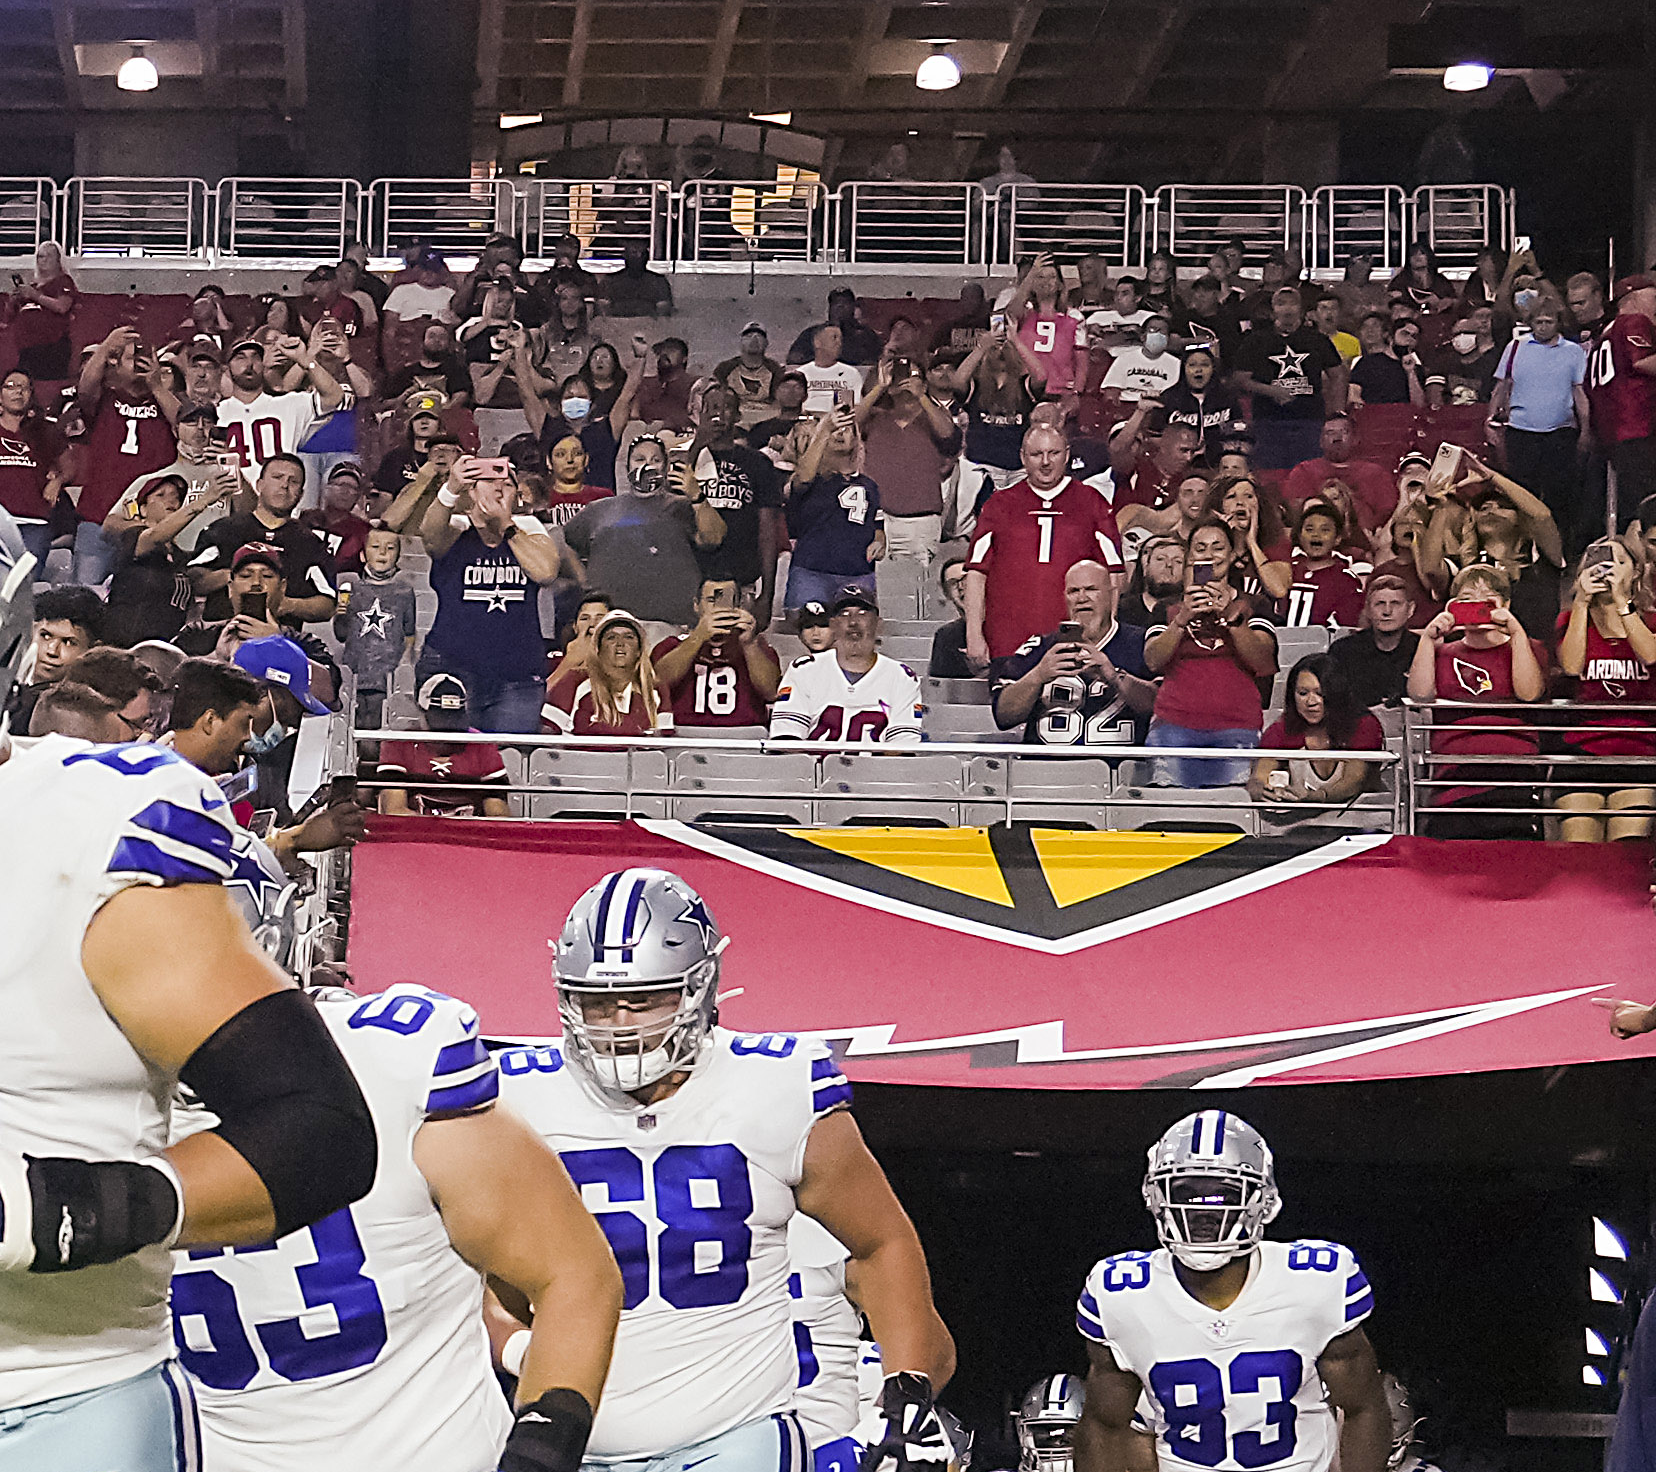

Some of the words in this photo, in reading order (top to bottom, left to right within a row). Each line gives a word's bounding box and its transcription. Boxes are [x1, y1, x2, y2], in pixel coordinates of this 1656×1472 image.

[1034, 321, 1055, 353] 9
[120, 419, 138, 455] 1
[226, 416, 282, 468] 40
[837, 485, 869, 525] 4
[1035, 516, 1053, 564] 1
[464, 565, 528, 586] COWBOYS
[1285, 589, 1314, 628] 11
[694, 664, 737, 715] 18
[1037, 676, 1136, 746] 82
[560, 1143, 756, 1310] 68
[1148, 1350, 1303, 1470] 83
